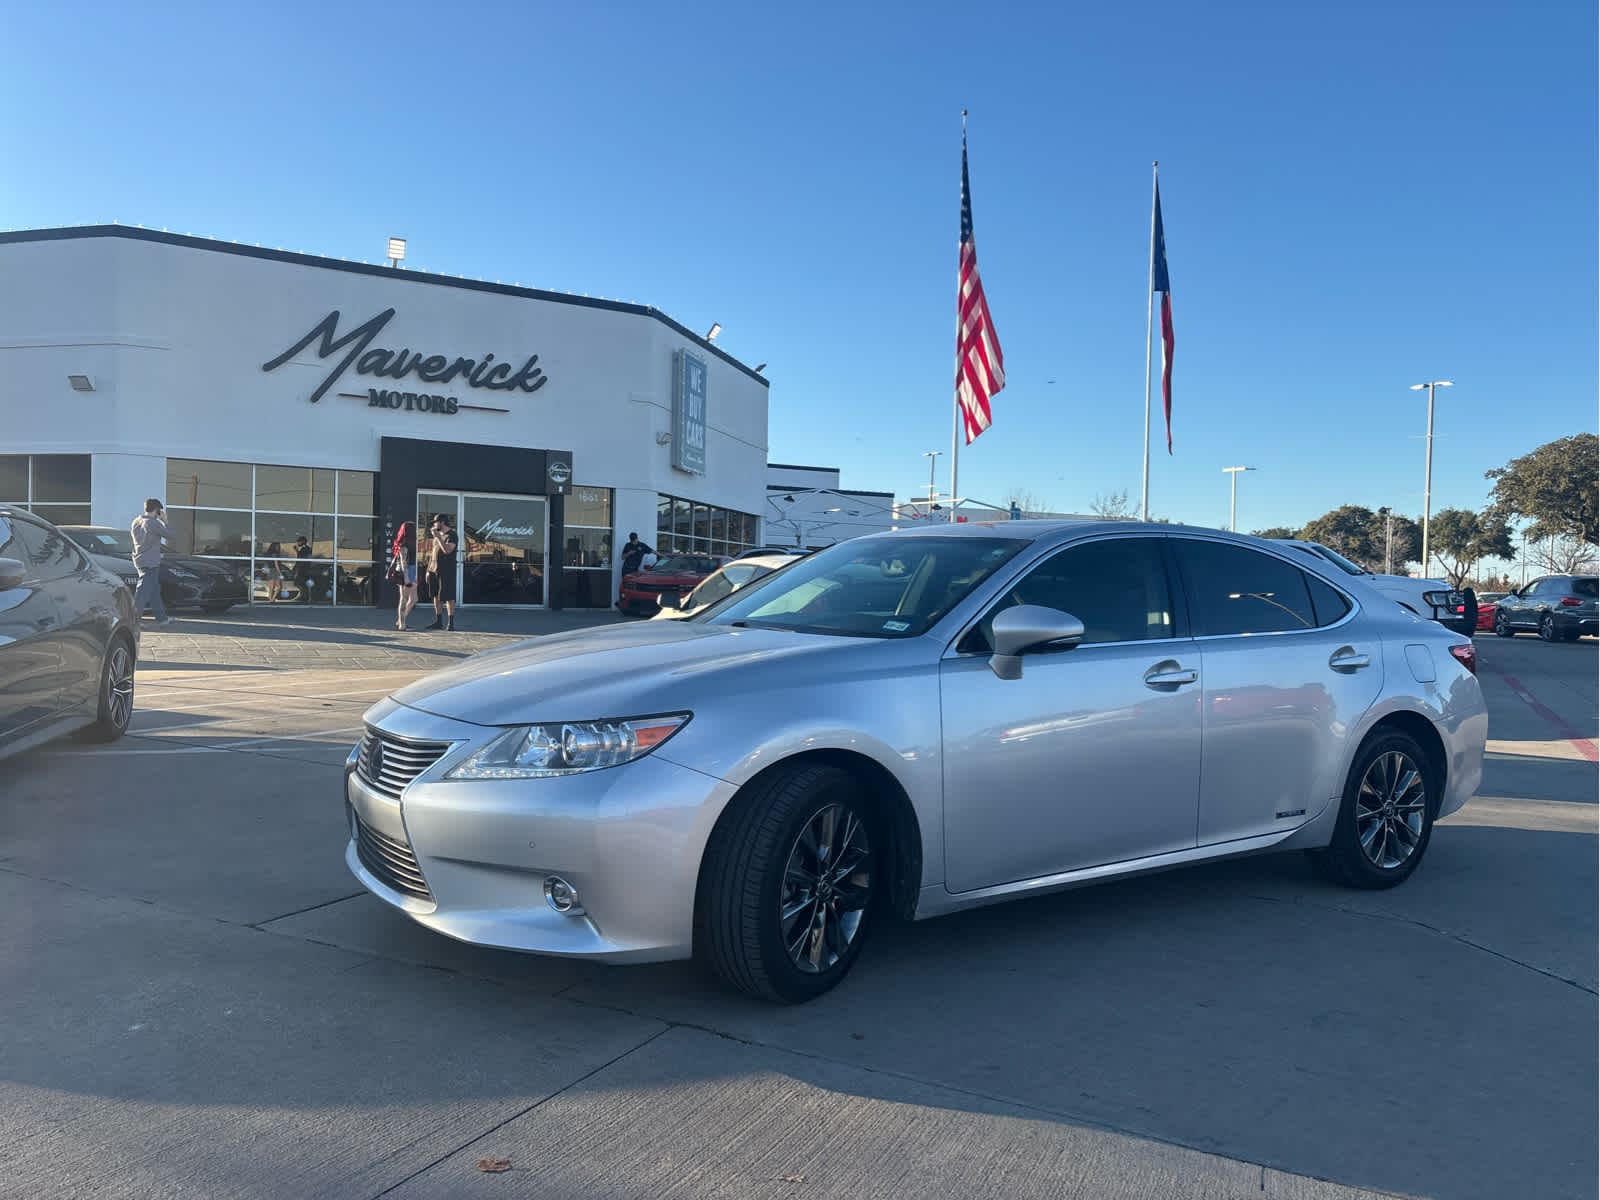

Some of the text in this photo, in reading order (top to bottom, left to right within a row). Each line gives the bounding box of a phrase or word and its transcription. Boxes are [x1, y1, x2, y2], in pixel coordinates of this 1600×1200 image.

[262, 307, 548, 403] Maverick
[690, 365, 703, 393] WE
[368, 388, 459, 414] MOTORS
[689, 392, 704, 421] BUY
[686, 420, 704, 449] CARS
[475, 518, 535, 540] Maverick
